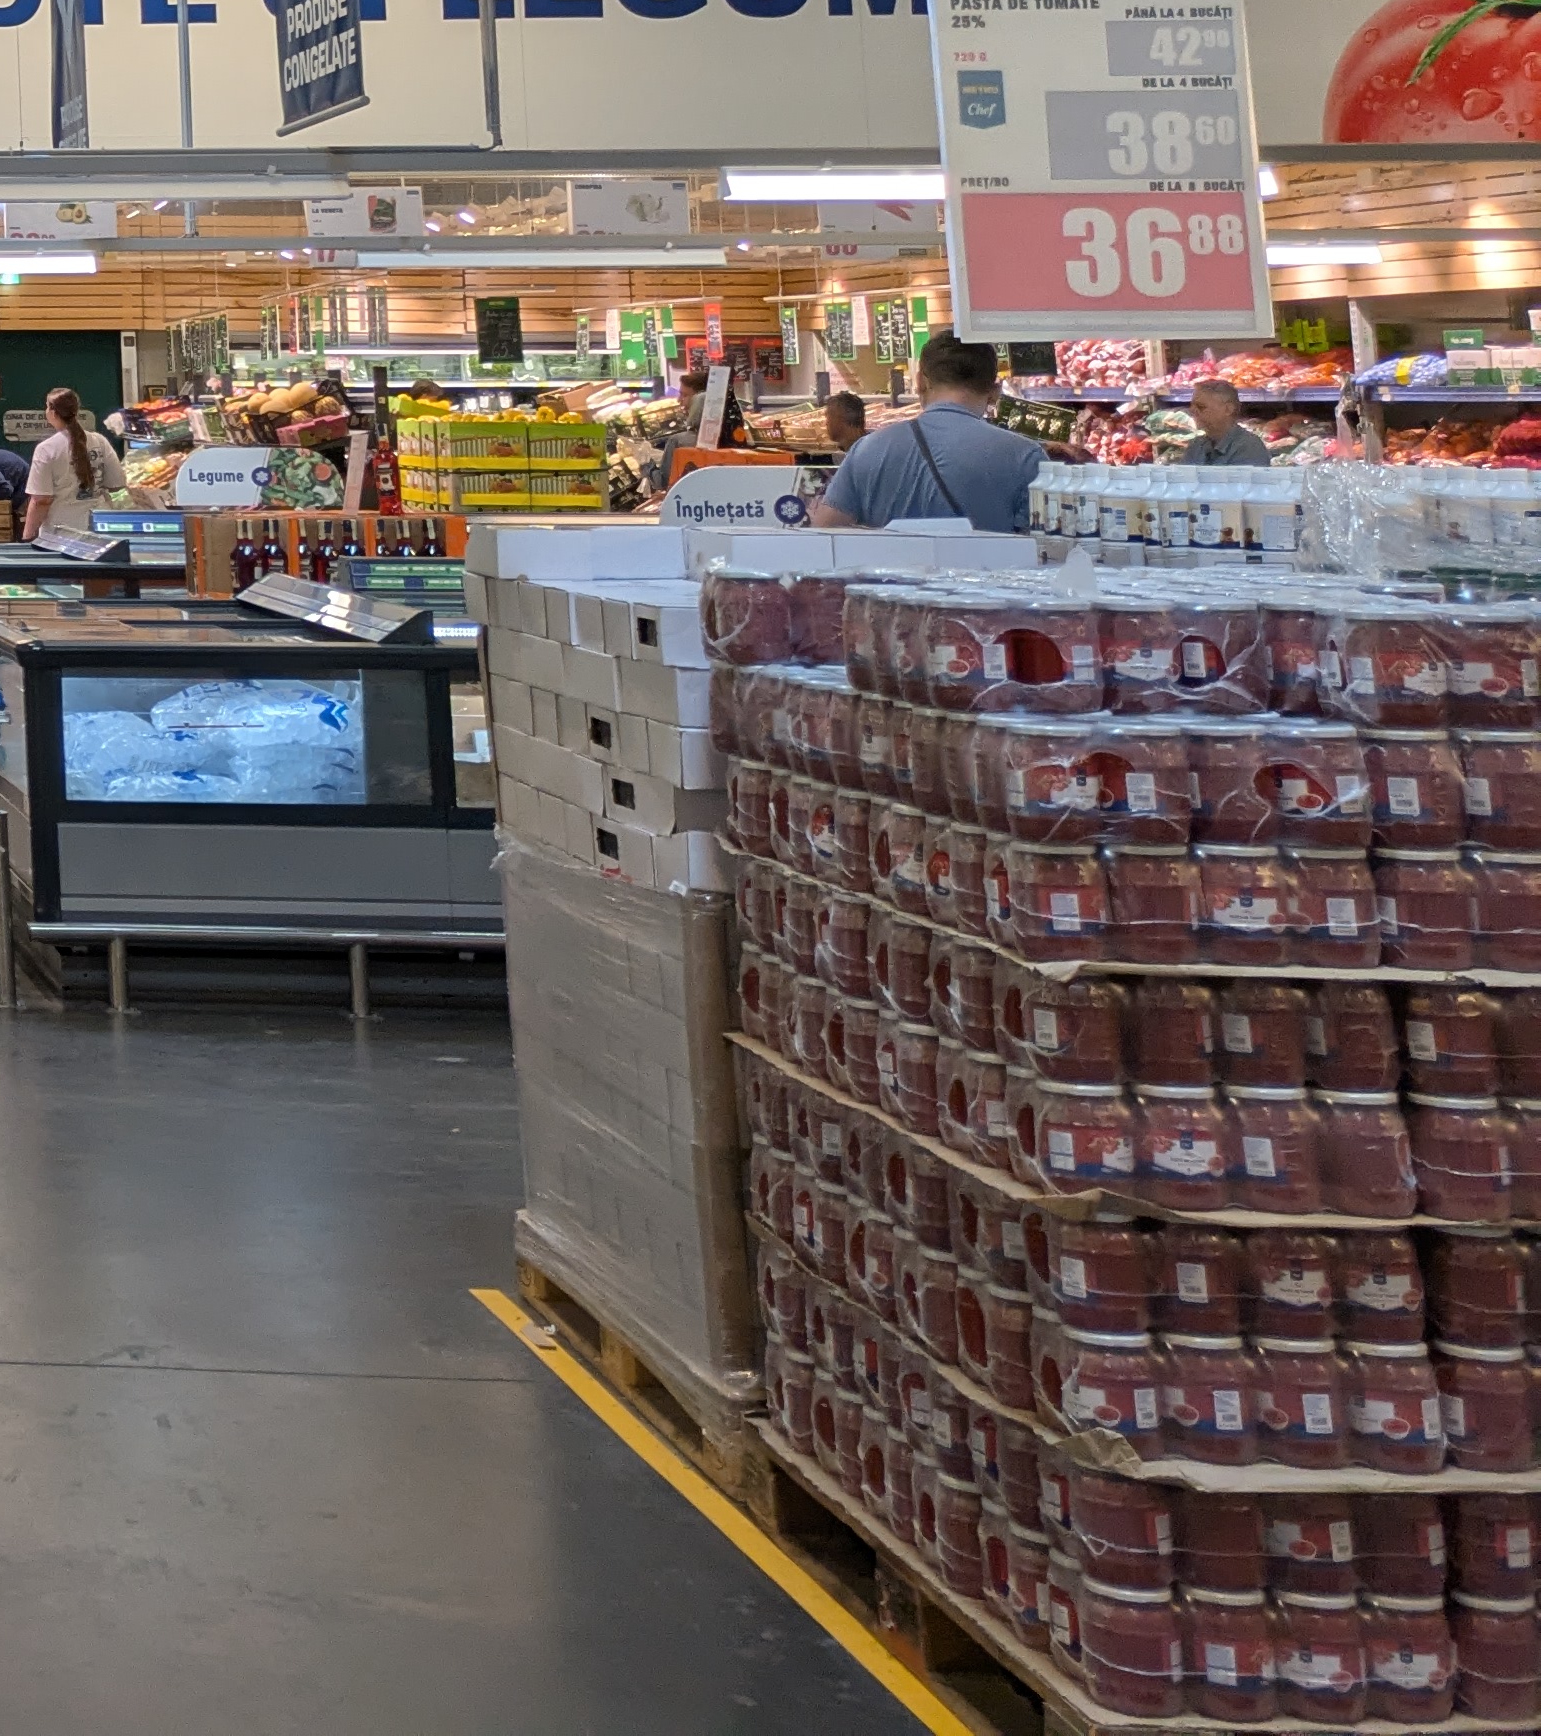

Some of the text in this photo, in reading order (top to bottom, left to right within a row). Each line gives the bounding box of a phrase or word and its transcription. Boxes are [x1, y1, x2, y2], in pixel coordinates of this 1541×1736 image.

[1159, 8, 1174, 18] LA
[1176, 9, 1184, 18] 4
[951, 15, 985, 28] 25%
[284, 27, 356, 93] CONGELATE
[1142, 78, 1157, 88] DE
[1160, 78, 1174, 88] LA
[1179, 77, 1187, 88] 4
[967, 103, 997, 118] Chef
[1149, 182, 1165, 192] DE
[1167, 182, 1181, 192] LA
[188, 468, 244, 486] Legume
[674, 494, 765, 523] Înghețată
